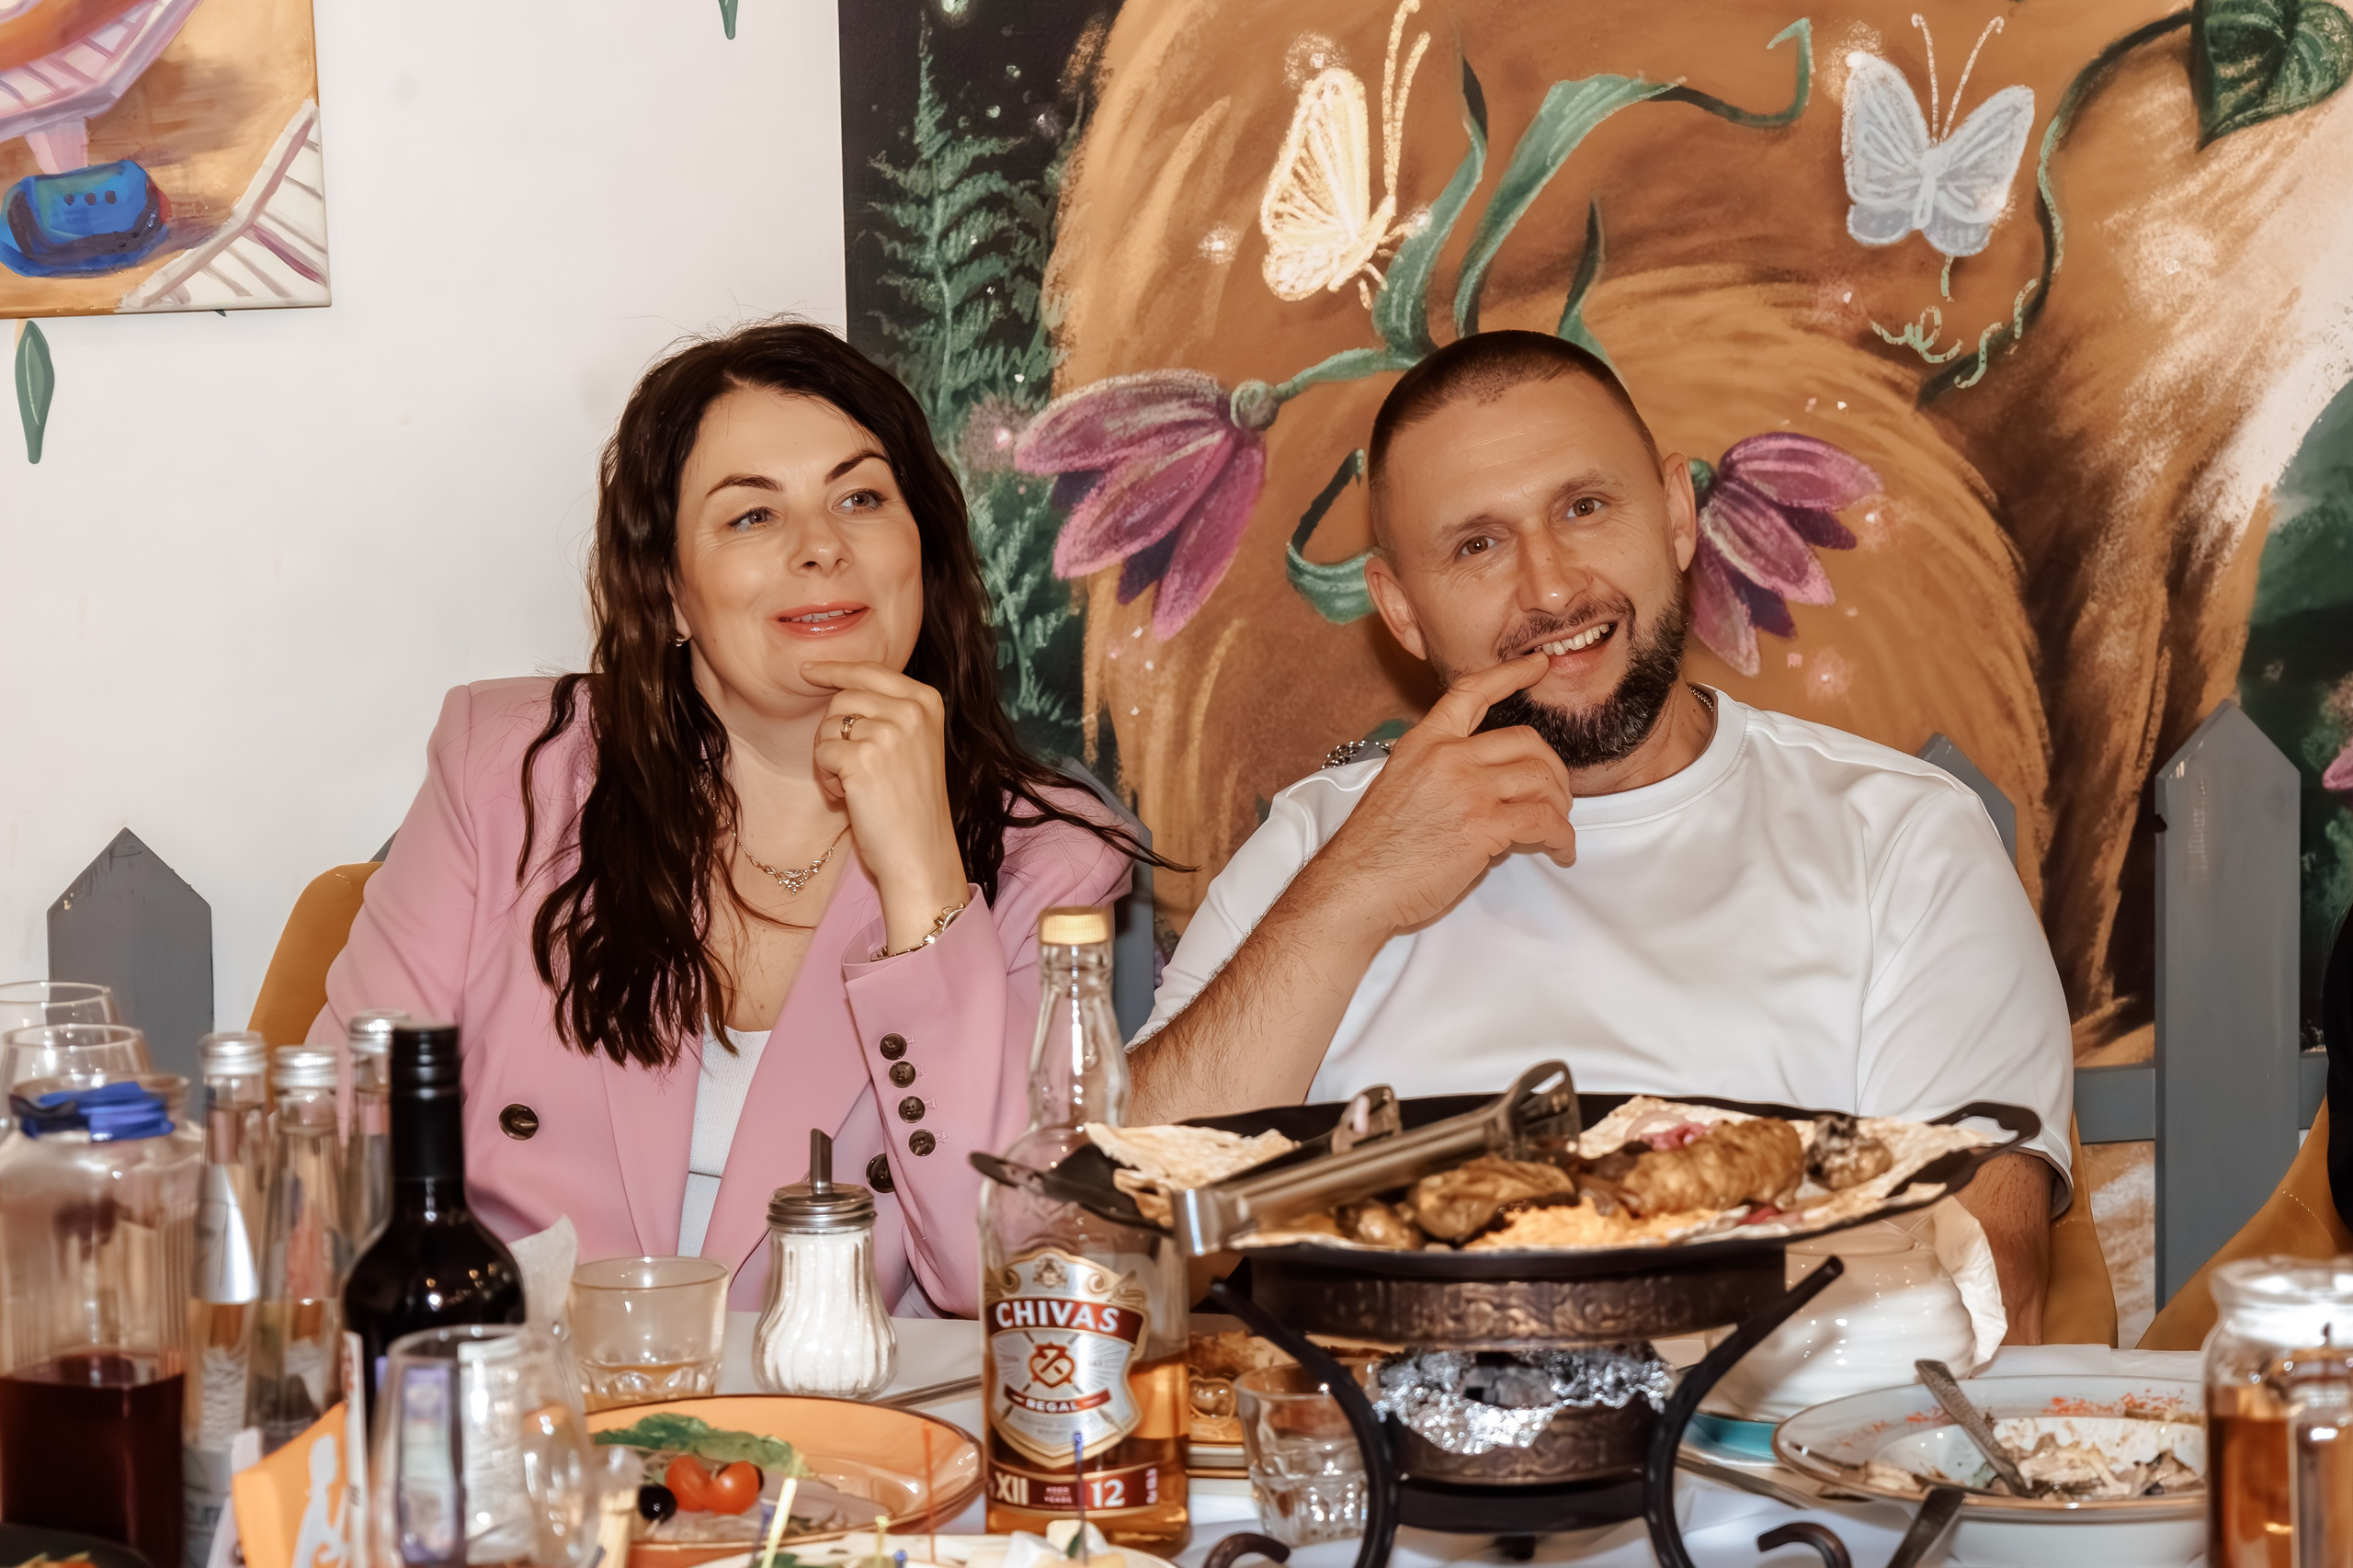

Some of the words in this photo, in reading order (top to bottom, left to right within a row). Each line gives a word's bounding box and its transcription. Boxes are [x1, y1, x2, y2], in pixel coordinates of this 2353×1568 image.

[995, 1301, 1120, 1333] CHIVAS
[1026, 1399, 1078, 1413] REGAL
[995, 1471, 1029, 1506] XII
[1090, 1479, 1125, 1508] 12
